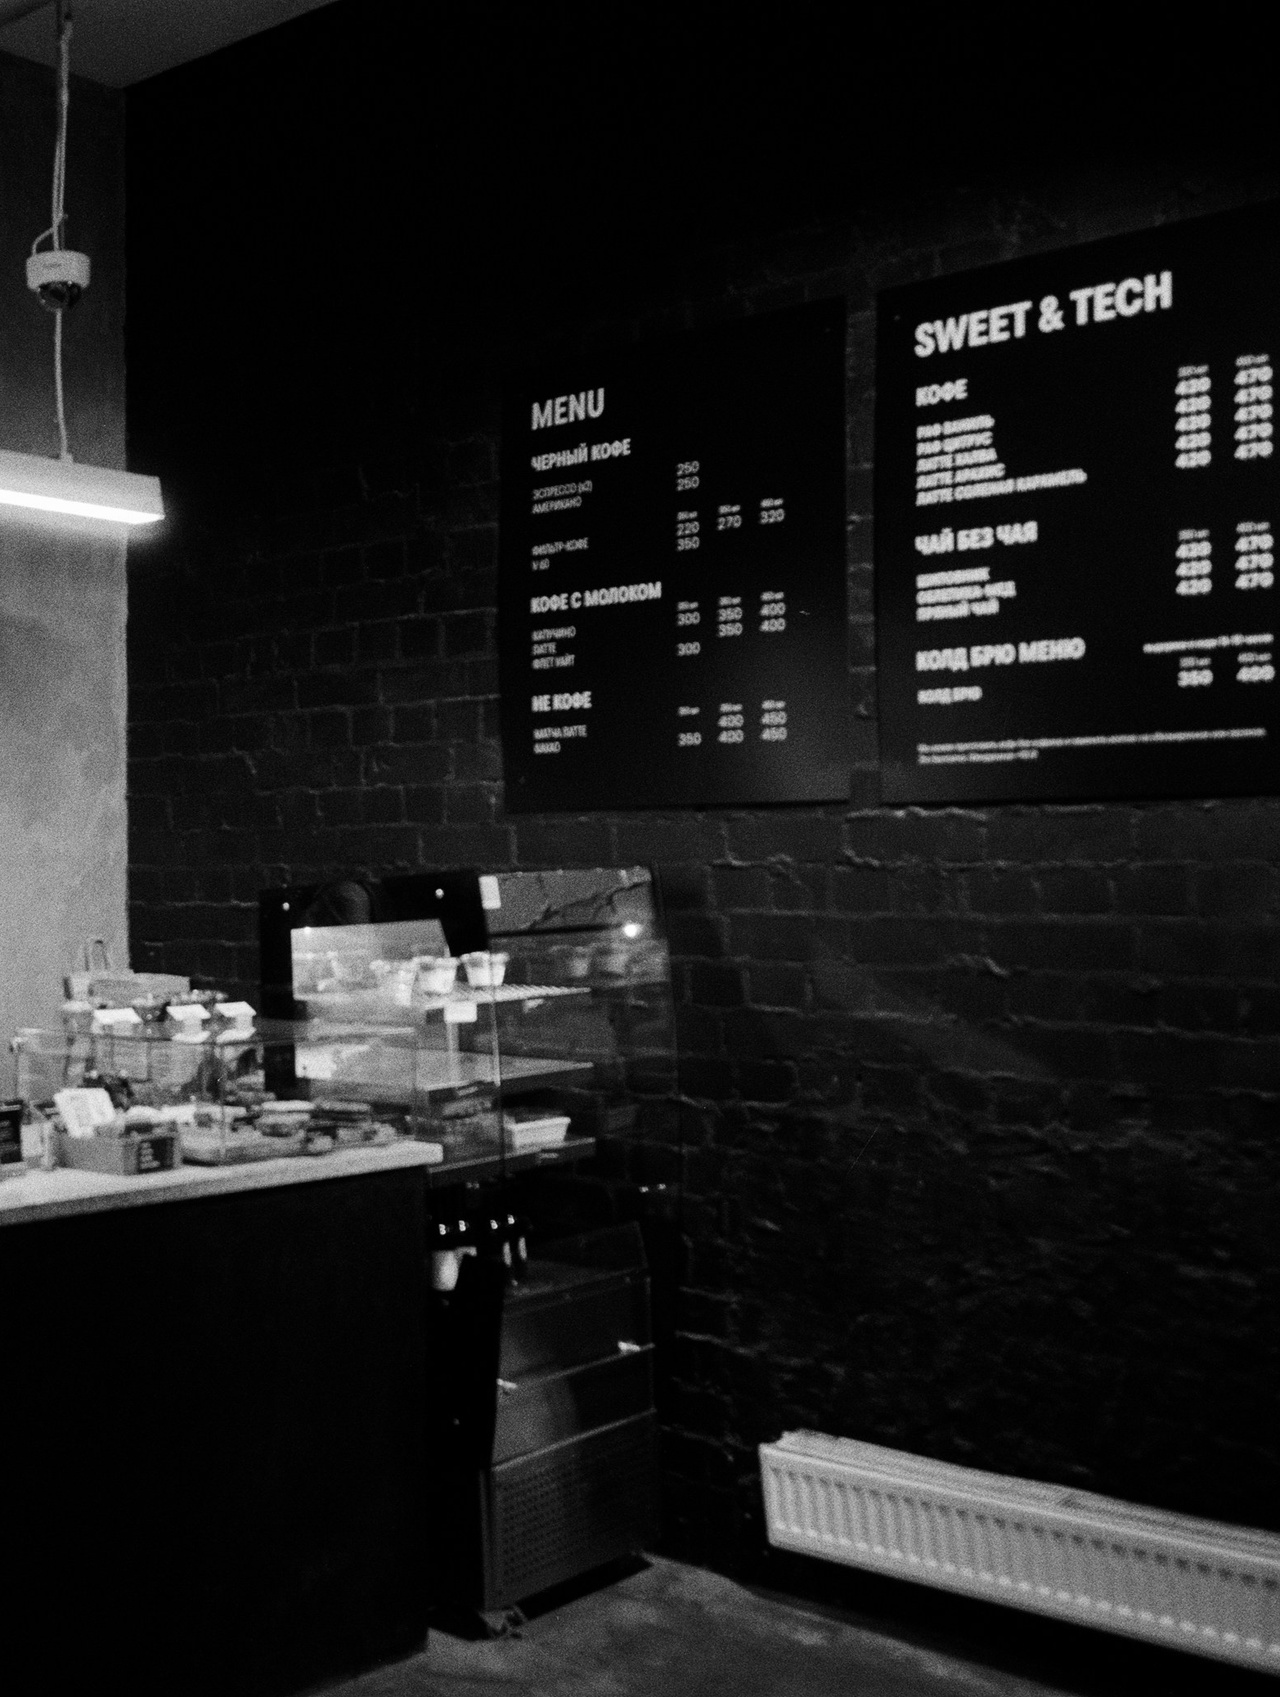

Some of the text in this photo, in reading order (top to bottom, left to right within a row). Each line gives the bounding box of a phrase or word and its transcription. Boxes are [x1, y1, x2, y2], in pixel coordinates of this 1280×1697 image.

[915, 271, 1172, 357] SWEET & TECH
[532, 388, 604, 430] MENU
[531, 438, 630, 471] ЧЕРНЫЙ КОФЕ
[676, 460, 699, 476] 250
[676, 476, 699, 491] 250
[718, 515, 742, 531] 270
[915, 521, 1038, 555] ЧАЙ БЕЗ ЧАЯ
[531, 582, 662, 613] КОФЕ С МОЛОКОМ
[677, 612, 700, 626] 300
[678, 642, 700, 656] 300
[970, 644, 1016, 667] БРЮ
[1018, 637, 1086, 663] МЕНЮ
[532, 691, 591, 711] НЕ КОФЕ
